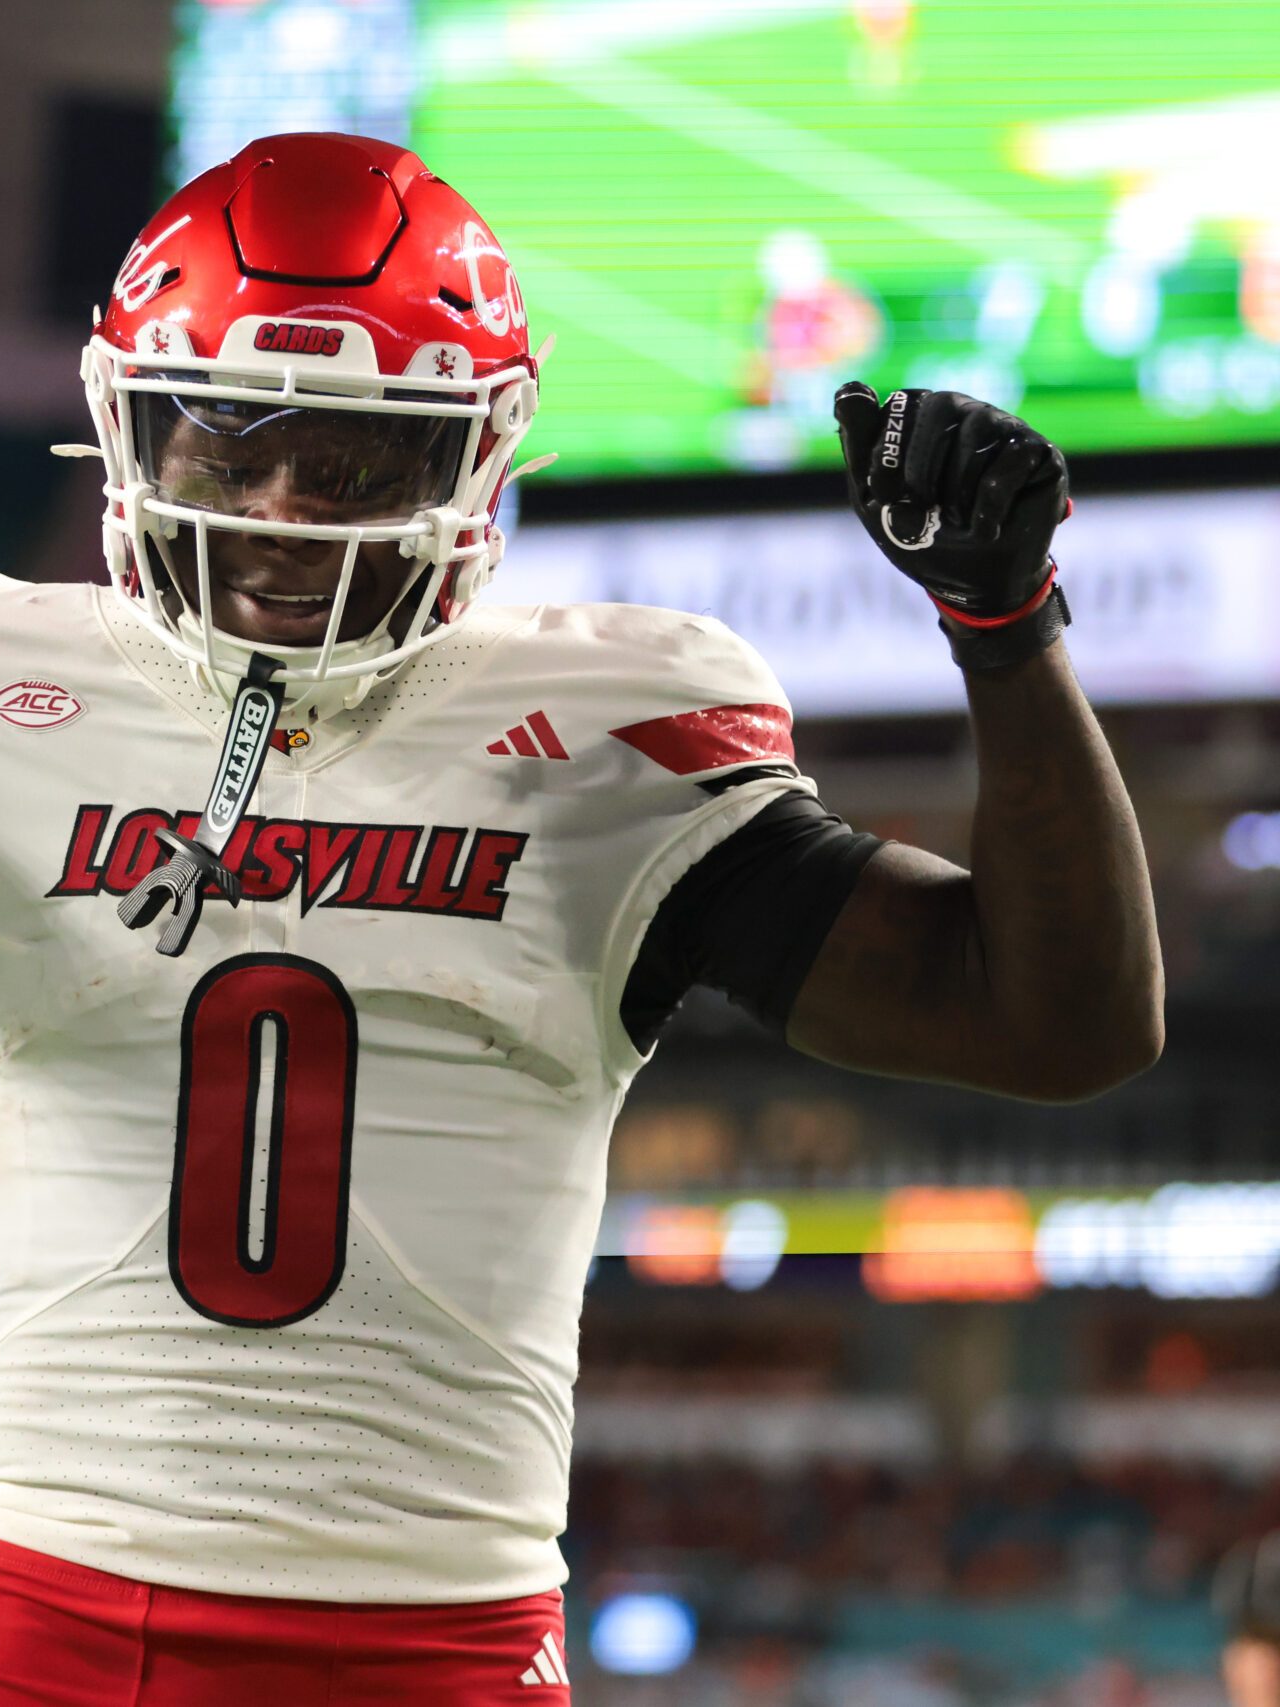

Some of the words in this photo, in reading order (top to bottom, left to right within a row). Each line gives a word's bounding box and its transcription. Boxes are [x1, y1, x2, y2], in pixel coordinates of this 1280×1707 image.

[254, 322, 344, 357] CARDS
[882, 391, 907, 468] ADIZERO
[3, 693, 70, 711] ACC
[214, 699, 267, 821] BATTLE
[44, 804, 530, 921] LOISVILLE
[168, 952, 358, 1328] 0
